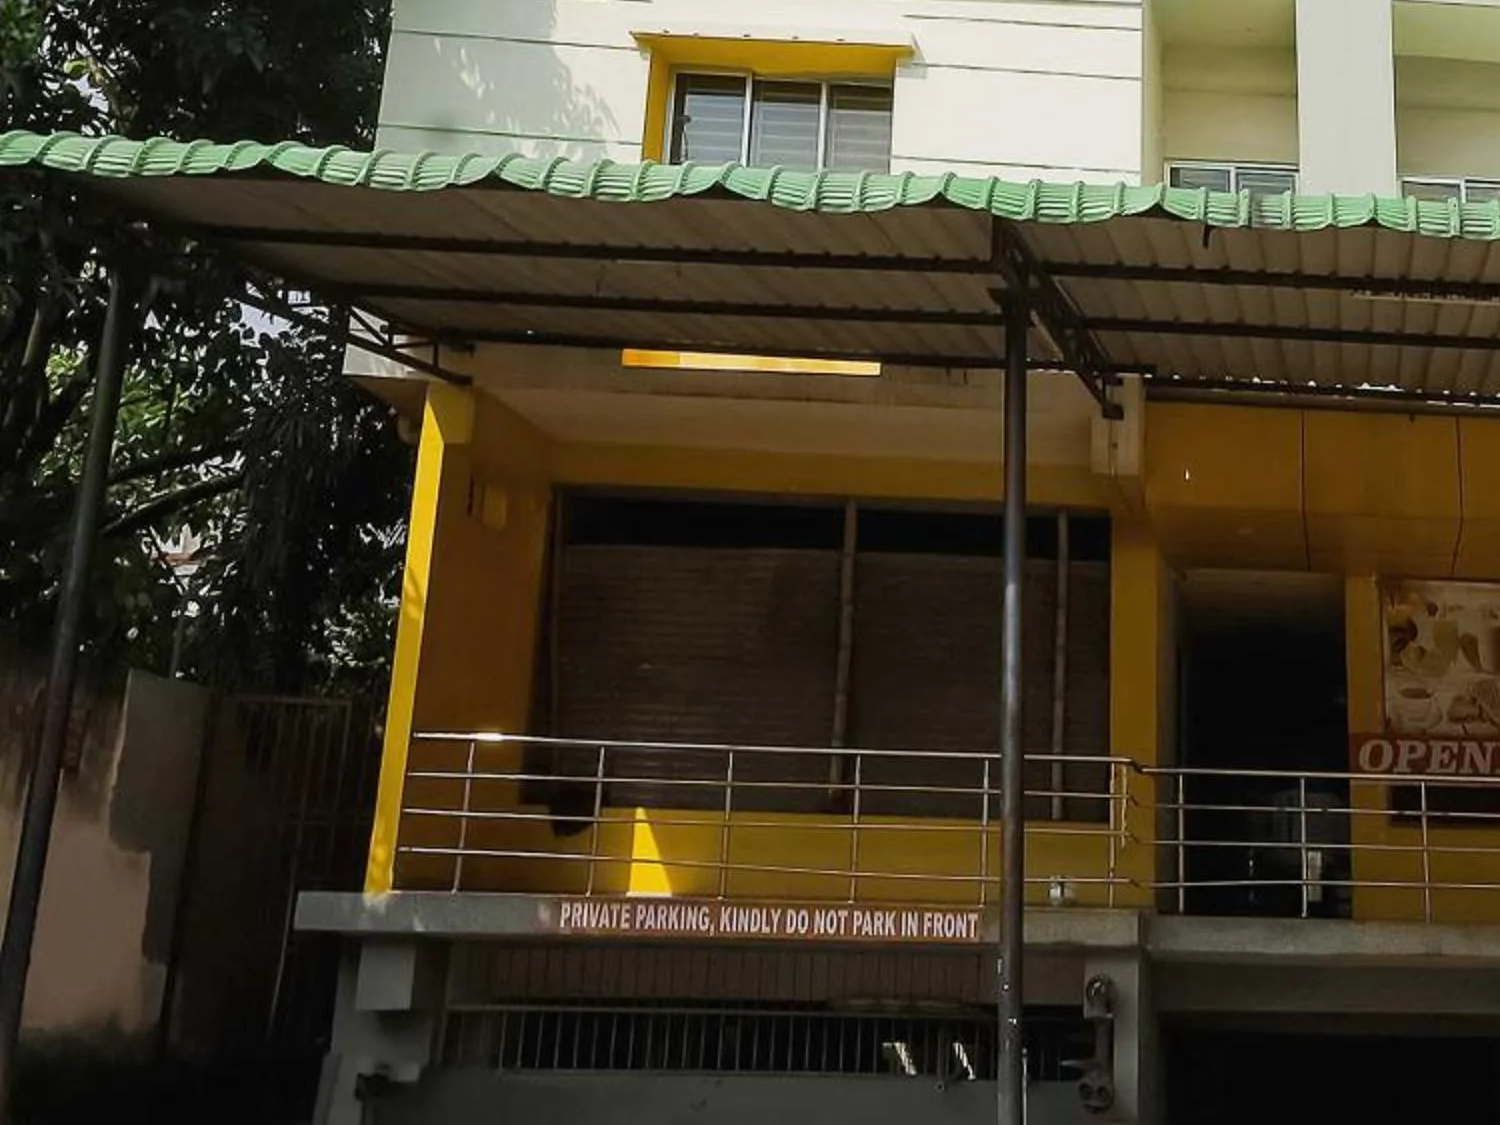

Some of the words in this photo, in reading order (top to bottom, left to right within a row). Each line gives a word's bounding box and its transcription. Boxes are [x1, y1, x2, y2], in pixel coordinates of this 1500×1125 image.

[560, 902, 631, 928] PRIVATE
[635, 904, 714, 936] PARKING,
[719, 906, 781, 934] KINDLY
[786, 908, 809, 934] DO
[813, 909, 848, 935] NOT
[852, 910, 896, 936] PARK
[901, 911, 918, 937] IN
[923, 912, 979, 938] FRONT
